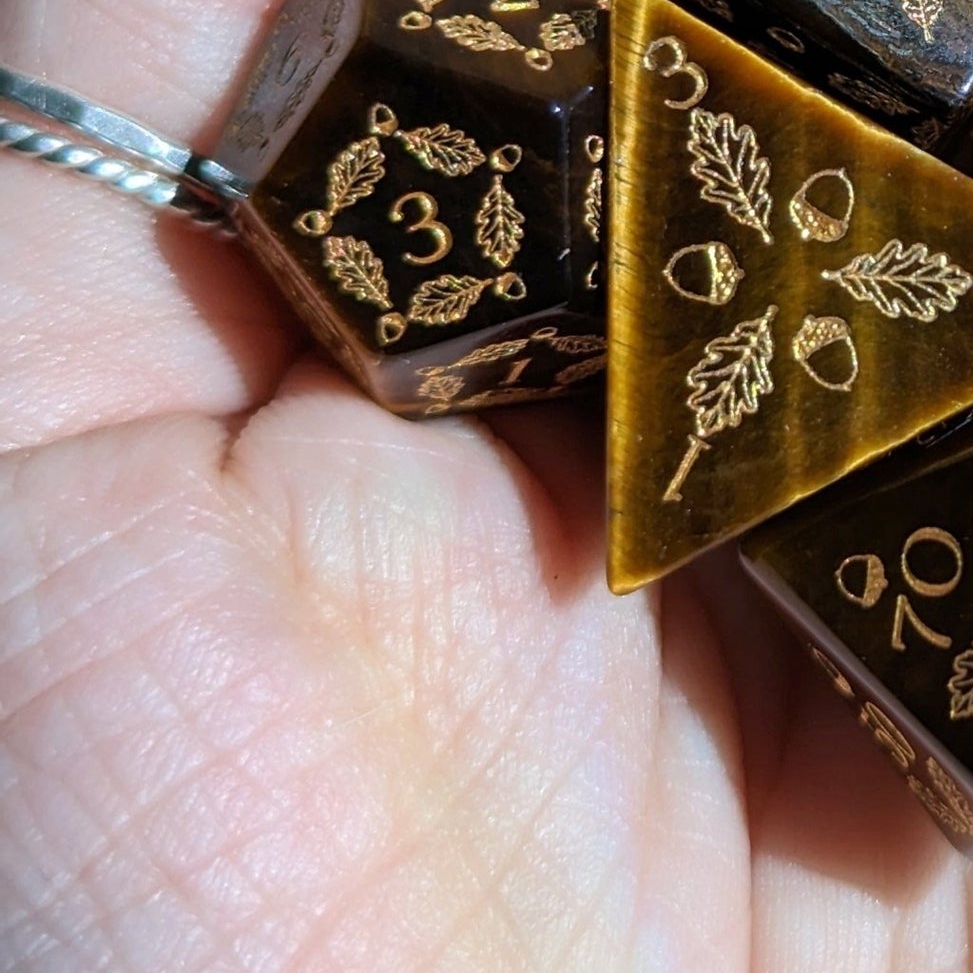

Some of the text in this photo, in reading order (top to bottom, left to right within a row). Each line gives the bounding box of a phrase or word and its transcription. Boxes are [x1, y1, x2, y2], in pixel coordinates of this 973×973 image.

[642, 36, 708, 110] 3
[390, 191, 453, 266] 3
[662, 433, 710, 502] 1
[891, 526, 964, 651] 70
